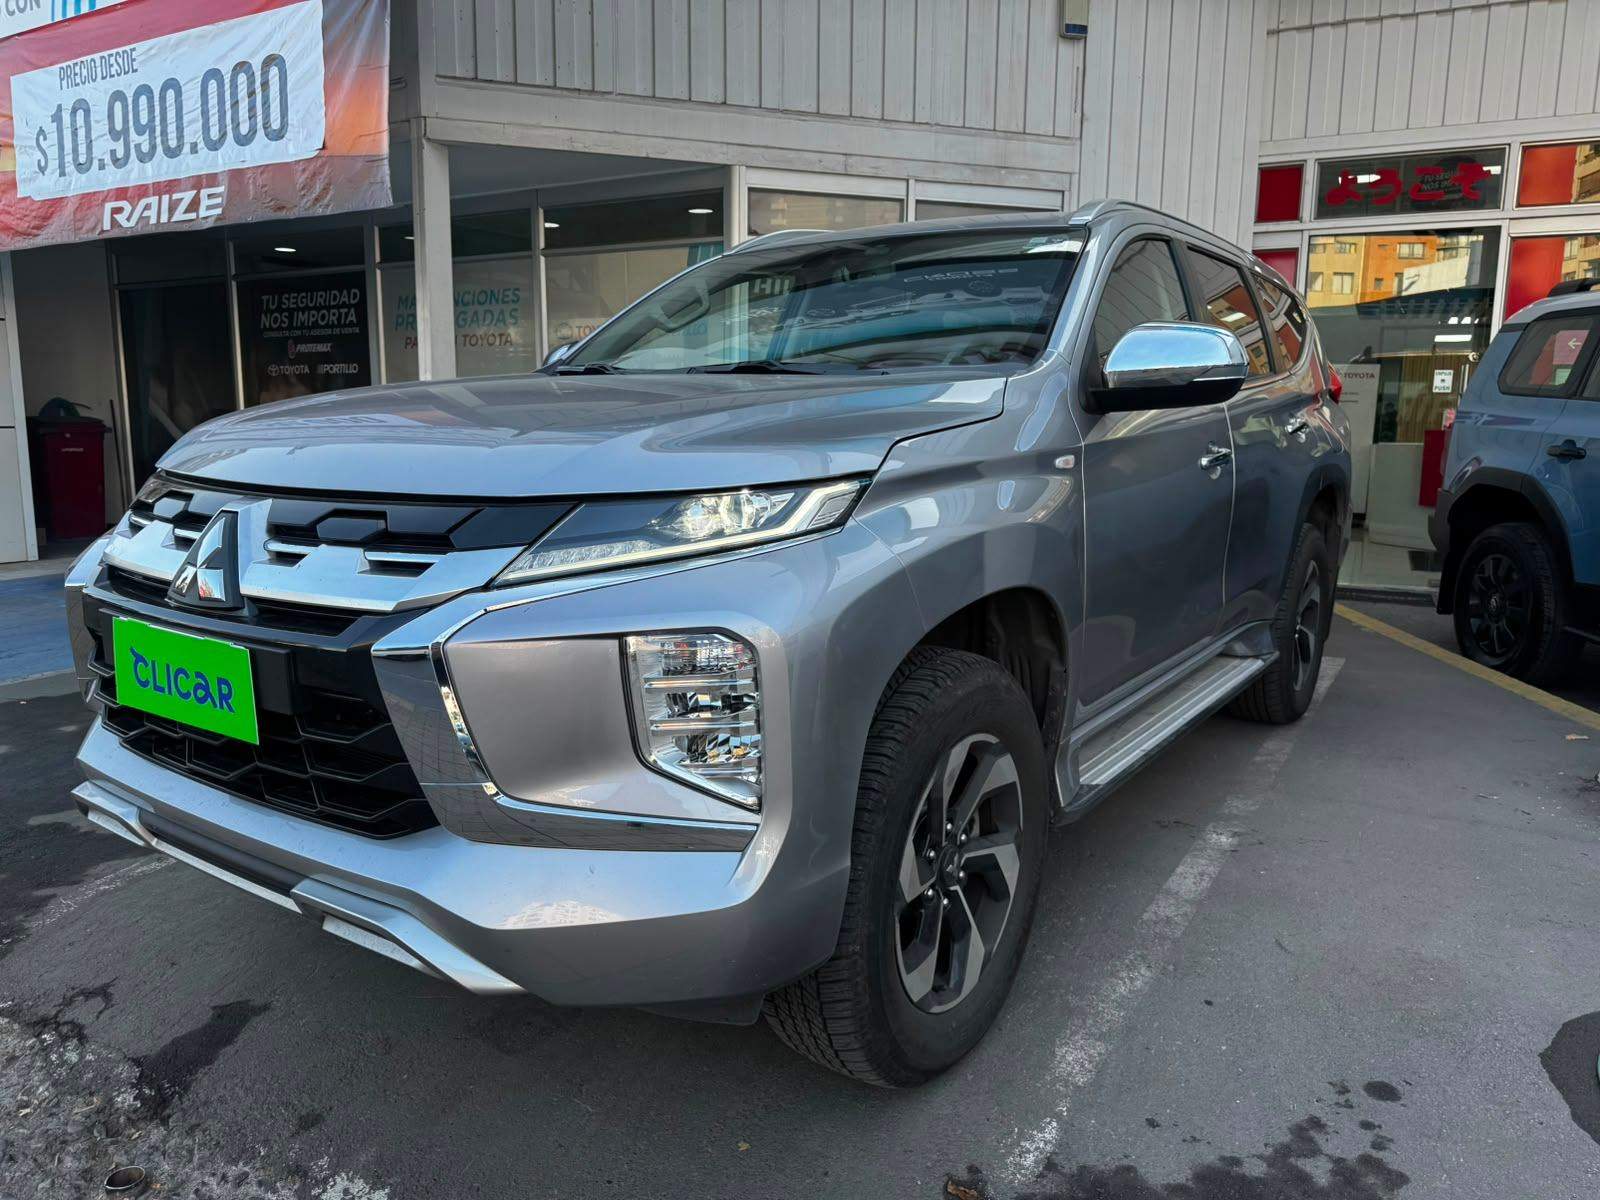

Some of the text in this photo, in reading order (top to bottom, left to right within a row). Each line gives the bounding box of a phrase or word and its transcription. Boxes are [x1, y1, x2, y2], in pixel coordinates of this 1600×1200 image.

[5, 0, 41, 17] CON
[59, 47, 138, 91] PRECIO DESDE
[36, 54, 289, 178] $10.990.000
[102, 185, 226, 231] RAIZE
[261, 289, 360, 310] TU SEGURIDAD
[397, 287, 521, 311] MANCIONES
[260, 307, 357, 329] NOS IMPORTA
[394, 308, 520, 332] PRGADAS
[463, 332, 513, 348] TOYOTA
[280, 363, 359, 375] TOYOTA PORTILLO
